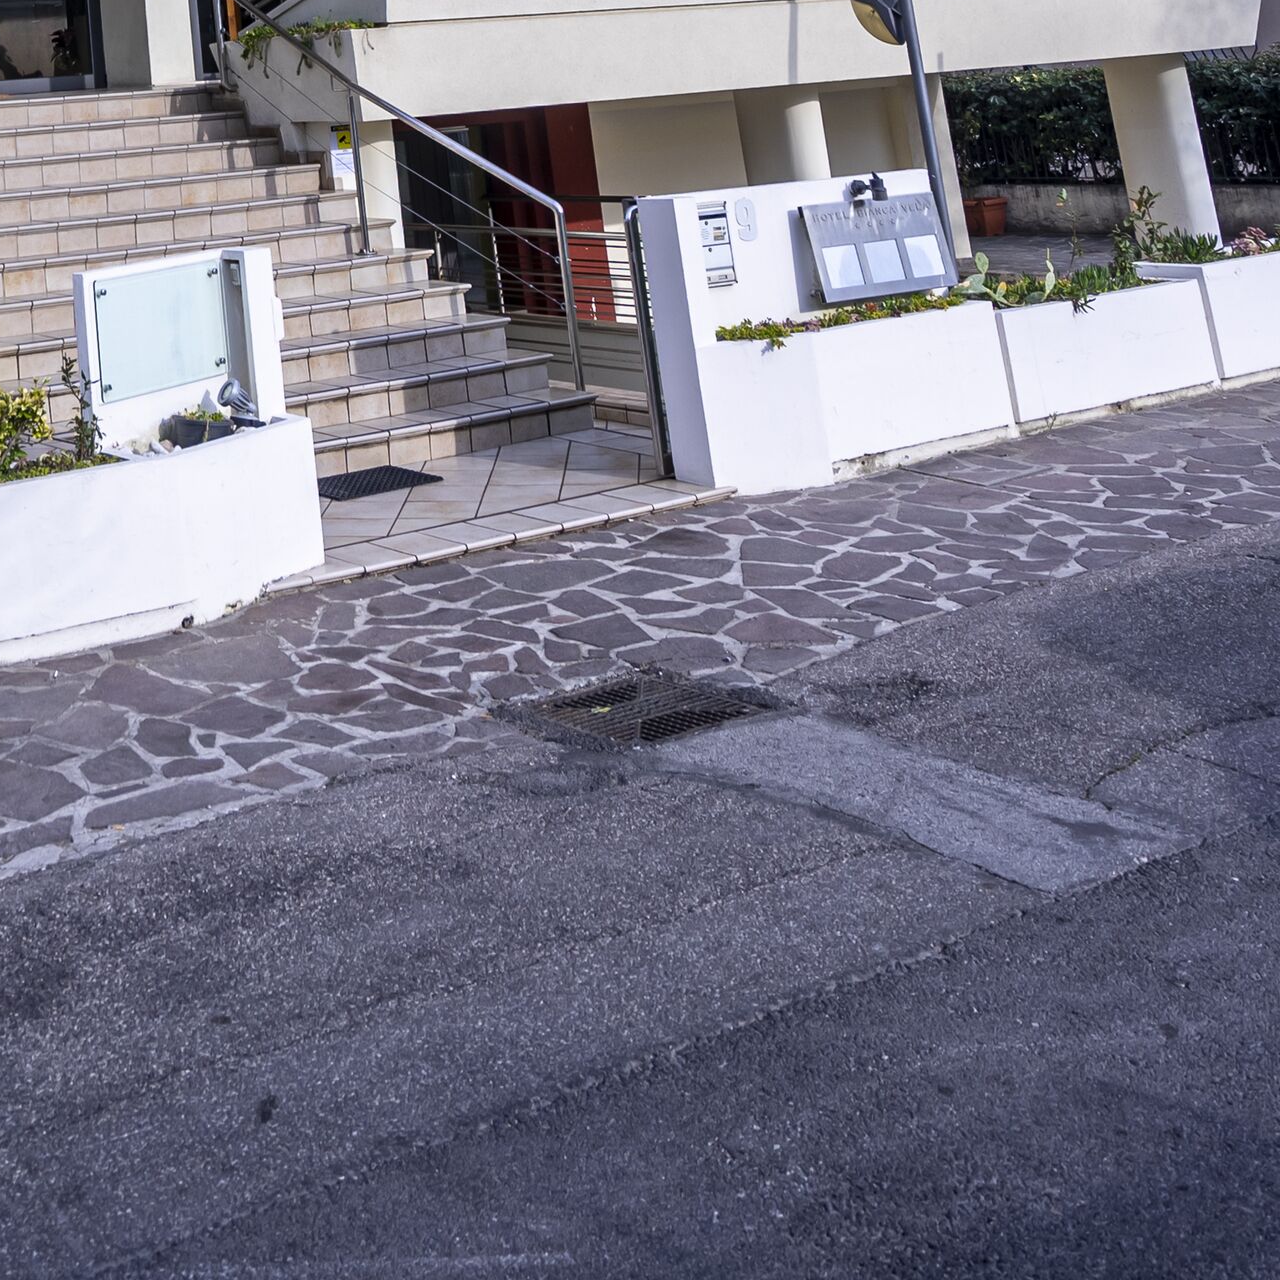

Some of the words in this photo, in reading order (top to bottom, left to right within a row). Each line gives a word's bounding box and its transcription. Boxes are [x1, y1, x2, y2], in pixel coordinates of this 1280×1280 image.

[734, 197, 758, 242] 9
[811, 209, 850, 223] HOTEL
[856, 205, 897, 217] BIANCA
